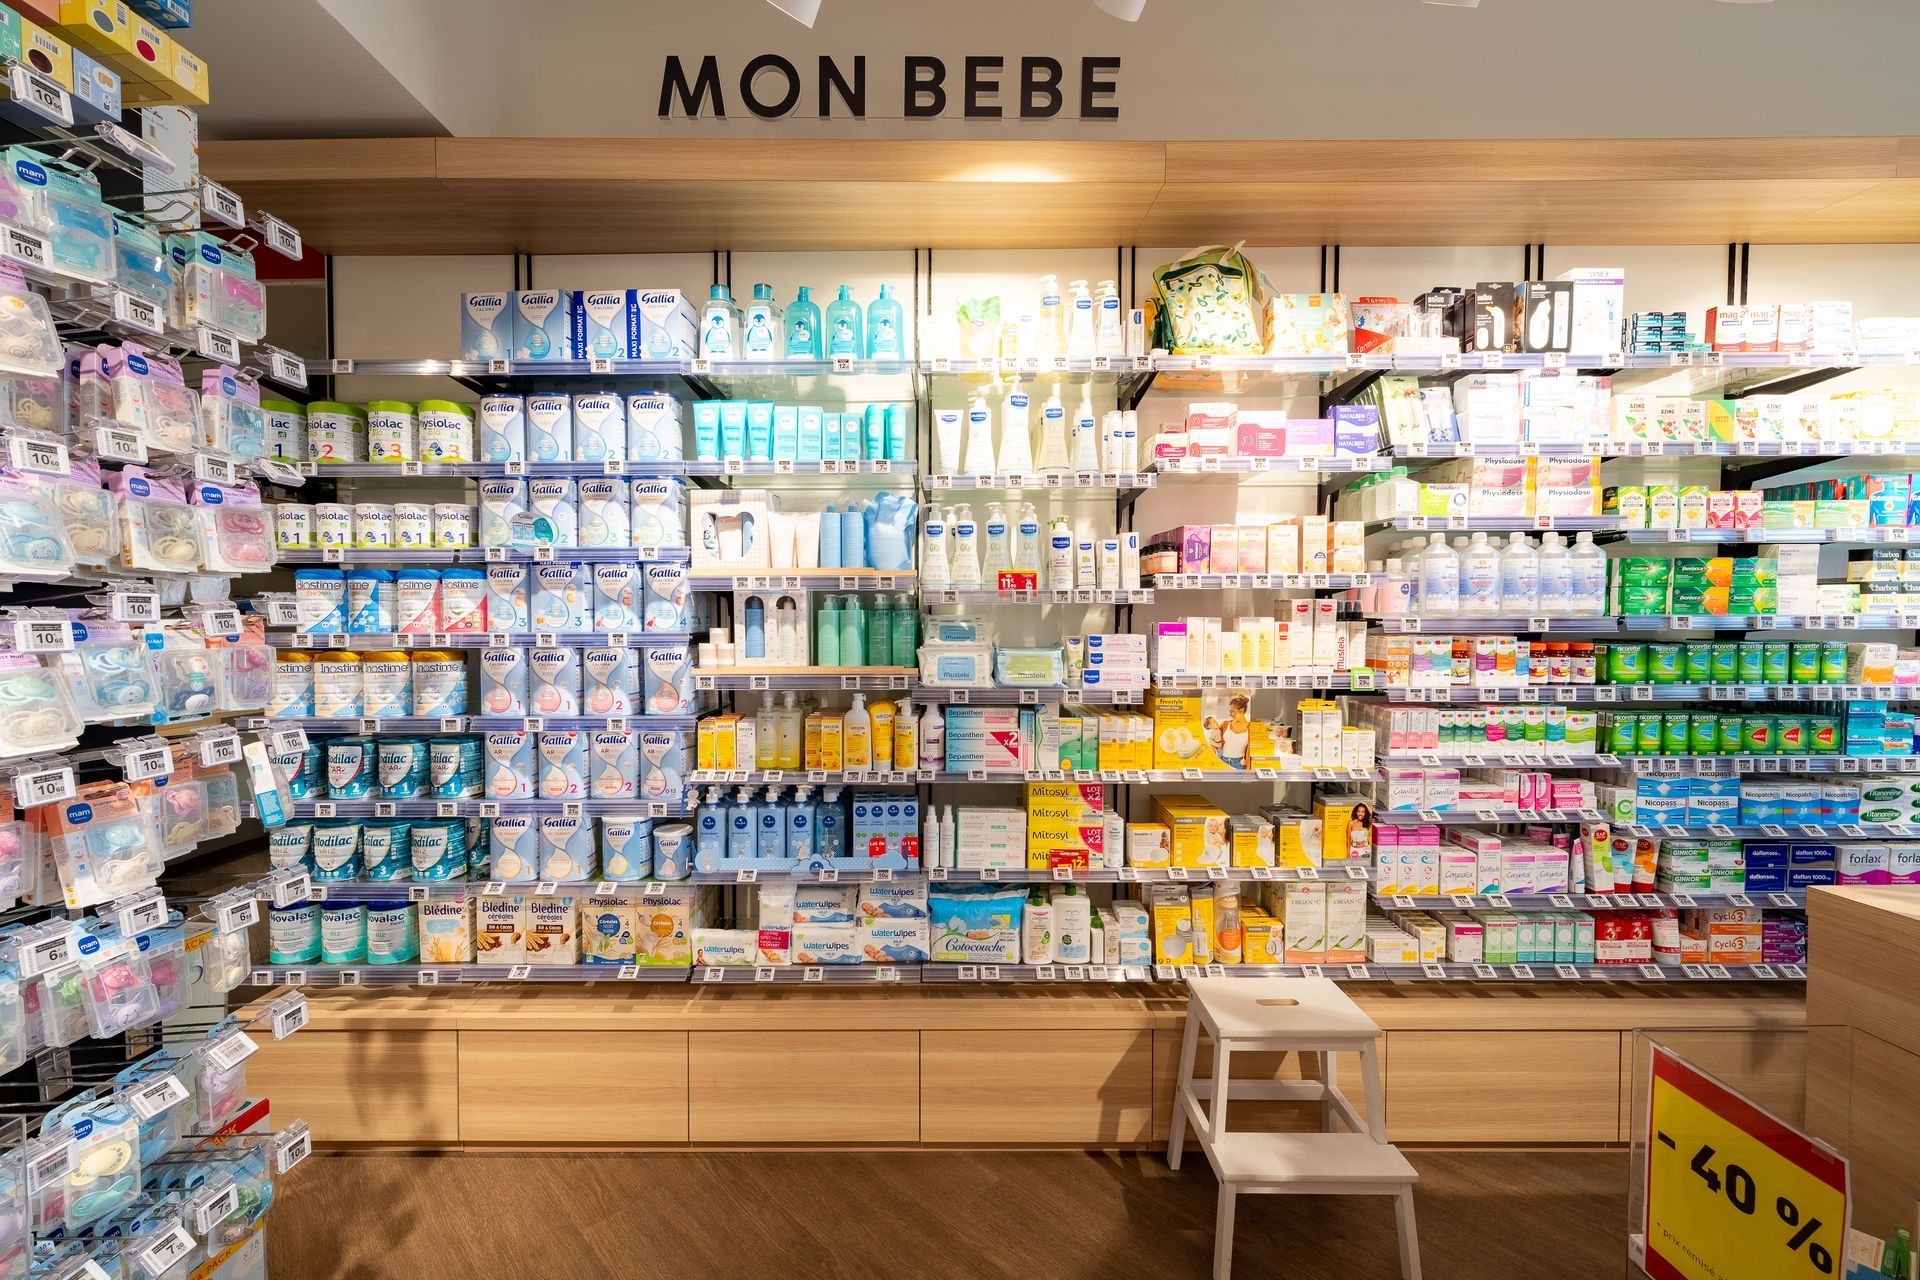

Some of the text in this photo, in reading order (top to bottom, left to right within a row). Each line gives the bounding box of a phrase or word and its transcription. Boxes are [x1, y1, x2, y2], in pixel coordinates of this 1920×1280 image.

[658, 54, 1121, 121] MON BEBE
[18, 166, 45, 179] mam
[202, 250, 220, 261] mam
[469, 295, 502, 308] Gallia
[521, 292, 554, 306] Gallia
[587, 295, 621, 306] Gallia
[641, 292, 675, 305] Gallia
[1719, 310, 1739, 321] mag
[1750, 310, 1770, 321] mag
[129, 358, 147, 371] mam
[484, 401, 515, 413] Gallia
[530, 400, 562, 411] Gallia
[578, 399, 610, 410] Gallia
[632, 399, 665, 410] Gallia
[309, 419, 337, 430] siolac
[419, 419, 461, 430] hysiolac
[274, 443, 283, 458] 1
[321, 444, 334, 460] 2
[390, 443, 401, 459] 3
[448, 444, 460, 460] 3
[1485, 457, 1526, 466] Physiodose
[1549, 457, 1590, 465] Physiodose
[131, 483, 149, 493] mam
[482, 484, 515, 495] Gallia
[532, 484, 563, 495] Gallia
[581, 483, 613, 494] Gallia
[635, 483, 667, 495] Gallia
[1482, 489, 1524, 497] Physiodose
[1548, 489, 1592, 497] Physiodose
[203, 492, 222, 500] mam
[317, 512, 350, 521] ysiolac
[1875, 551, 1899, 559] Charbon
[1876, 562, 1898, 571] Belloc
[490, 568, 521, 579] Gallia
[539, 567, 573, 579] Gallia
[597, 567, 628, 579] Gallia
[1871, 584, 1899, 592] Charbon
[1872, 596, 1896, 605] Belloc
[626, 617, 634, 627] 4
[1687, 642, 1711, 650] nicorette
[1712, 642, 1737, 650] nicorette
[1739, 642, 1763, 650] nicorette
[1765, 642, 1789, 650] nicorette
[1793, 642, 1820, 650] nicorette
[1823, 642, 1847, 650] nicorette
[949, 709, 984, 718] Bepanthen
[1665, 713, 1689, 721] nicorette
[949, 731, 984, 740] Bepanthen
[1003, 733, 1018, 748] x2
[330, 752, 358, 764] odilac
[949, 752, 984, 761] Bepanthen
[352, 782, 361, 793] 2
[1032, 787, 1069, 799] Mitosyl
[1086, 786, 1101, 794] LOT
[1087, 792, 1101, 802] x2
[1645, 799, 1677, 809] Nicopass
[1697, 799, 1730, 809] Nicopass
[68, 808, 90, 820] mam
[1032, 809, 1069, 820] Mitosyl
[1032, 830, 1069, 842] Mitosyl
[1087, 828, 1101, 836] LOT
[1087, 835, 1101, 844] x2
[1709, 840, 1732, 848] GINKOR
[1673, 849, 1697, 857] GINKOR
[1849, 853, 1881, 864] forlax
[1897, 853, 1920, 864] forla
[1710, 869, 1734, 877] GINKOR
[1793, 873, 1811, 881] daflon
[1674, 875, 1700, 883] GINKOR
[589, 897, 628, 907] Physiolac
[642, 896, 681, 907] Physiolac
[423, 904, 463, 916] Blédine
[271, 909, 316, 923] Novalac
[80, 940, 99, 952] mam
[185, 937, 206, 953] ACK
[945, 938, 1006, 953] Cotocouche
[1690, 1144, 1833, 1275] 40 %
[1663, 1228, 1717, 1277] prix remisé
[205, 1249, 233, 1273] PACK
